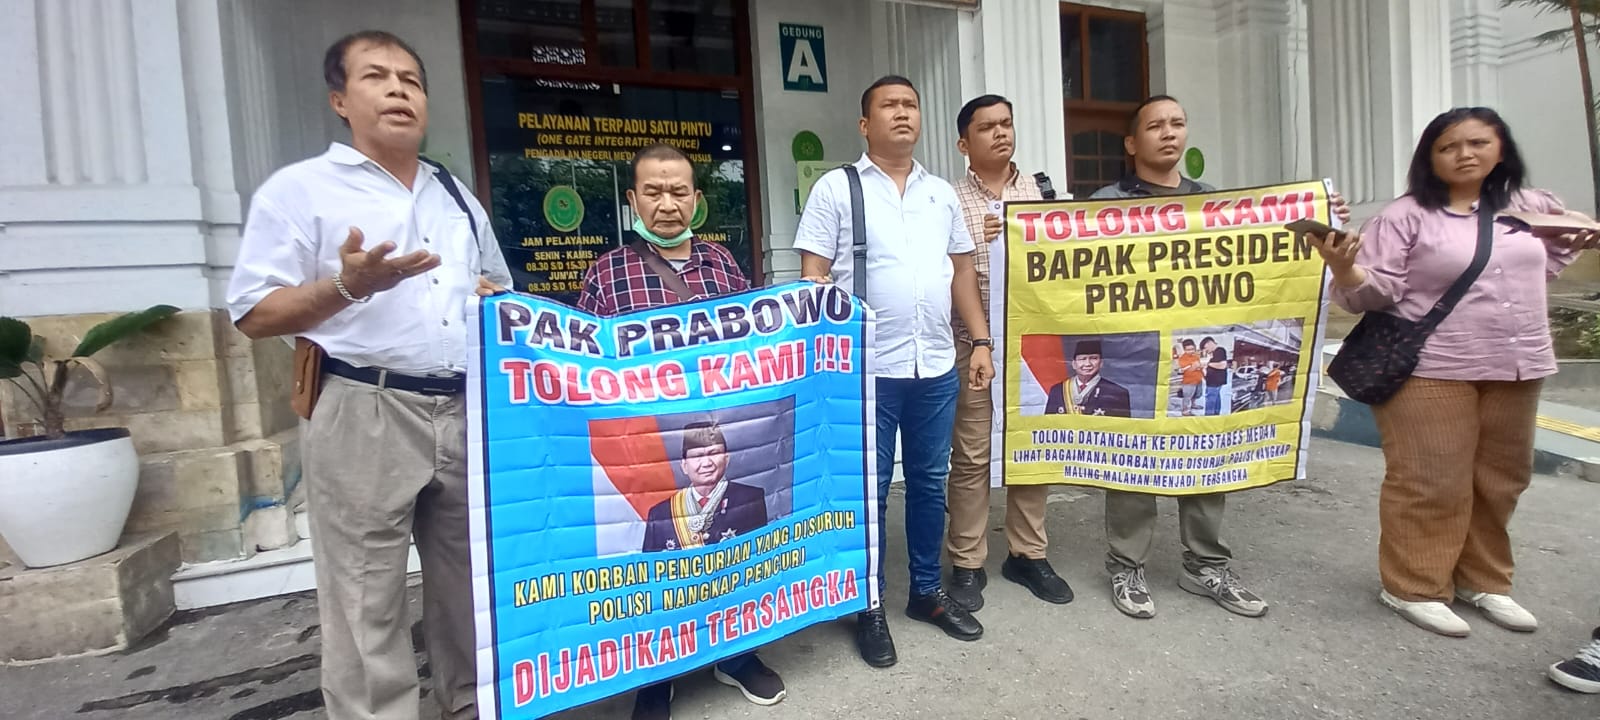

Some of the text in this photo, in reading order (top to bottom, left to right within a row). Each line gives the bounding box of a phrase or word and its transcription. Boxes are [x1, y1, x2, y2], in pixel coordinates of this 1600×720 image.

[782, 26, 822, 39] GEDUNG
[787, 39, 824, 84] A
[518, 112, 590, 131] PELAYANAN
[593, 116, 647, 134] TERPADU
[650, 120, 678, 135] SATU
[680, 121, 712, 137] PINTU
[537, 133, 563, 146] (ONE
[565, 135, 591, 145] GATE
[525, 148, 712, 163] PENGADILAN NEGERI MEDA USUS
[1016, 191, 1315, 242] TOLONG KAMI
[521, 237, 543, 246] JAM
[545, 236, 603, 246] PELAYANAN
[696, 232, 727, 241] YANAN
[526, 262, 549, 271] 08.30
[566, 261, 587, 270] 15.30
[534, 251, 560, 260] SENIN
[566, 250, 593, 259] KAMIS
[1026, 229, 1312, 283] BAPAK PRESIDEN
[528, 283, 551, 292] 08.30
[567, 281, 585, 290] 16.0
[549, 271, 578, 280] JUM'AT
[1085, 270, 1255, 315] PRABOWO
[498, 285, 853, 358] PAK PRABOWO
[503, 360, 687, 402] TOLONG
[702, 341, 806, 395] KAMI
[1032, 424, 1276, 450] TOLONG DATANGLAH KE POLRESTABES MEDAN
[1013, 444, 1291, 470] LIHAT BAGAIMANA KORBAN YANG DISURUH POLISI NANGKAP
[1064, 466, 1248, 488] MALING MALAHAN MENJADI TERSANGKA
[514, 511, 855, 608] KAMI KORBAN PENCURIAN YANG DISURUH
[589, 546, 806, 625] POLISI NANGKAP PENCURI
[514, 568, 859, 706] DIJADIKAN TERSANGKA
